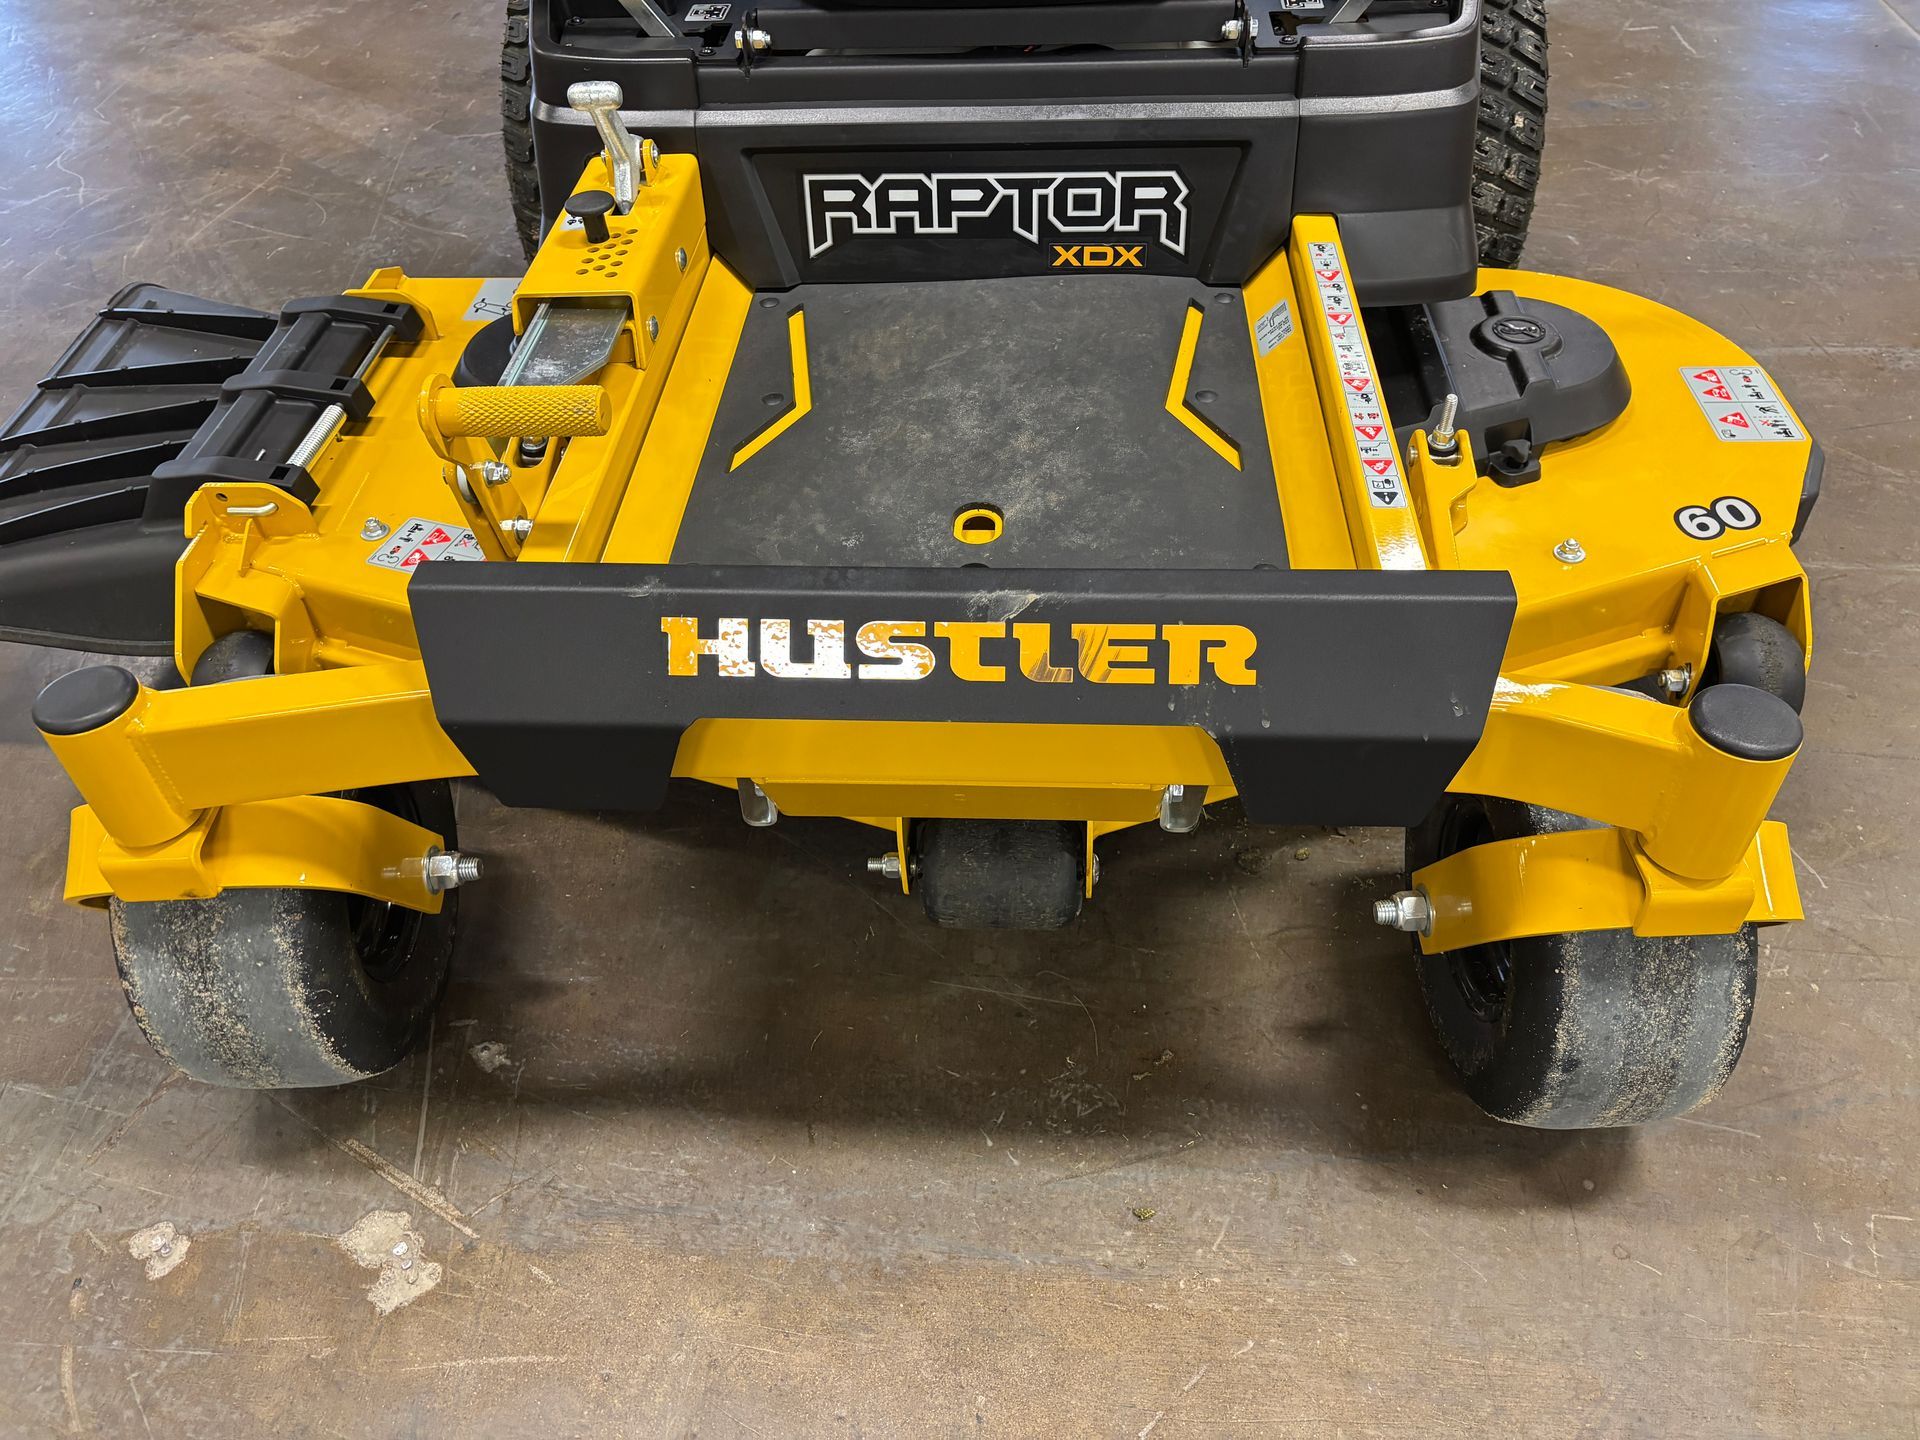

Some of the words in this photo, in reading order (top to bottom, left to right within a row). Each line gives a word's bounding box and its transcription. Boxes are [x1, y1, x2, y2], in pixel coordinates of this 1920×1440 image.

[803, 171, 1190, 258] RAPTOR
[1052, 246, 1143, 267] XDX
[1674, 496, 1761, 540] 60
[660, 616, 1257, 686] HUSTLER
